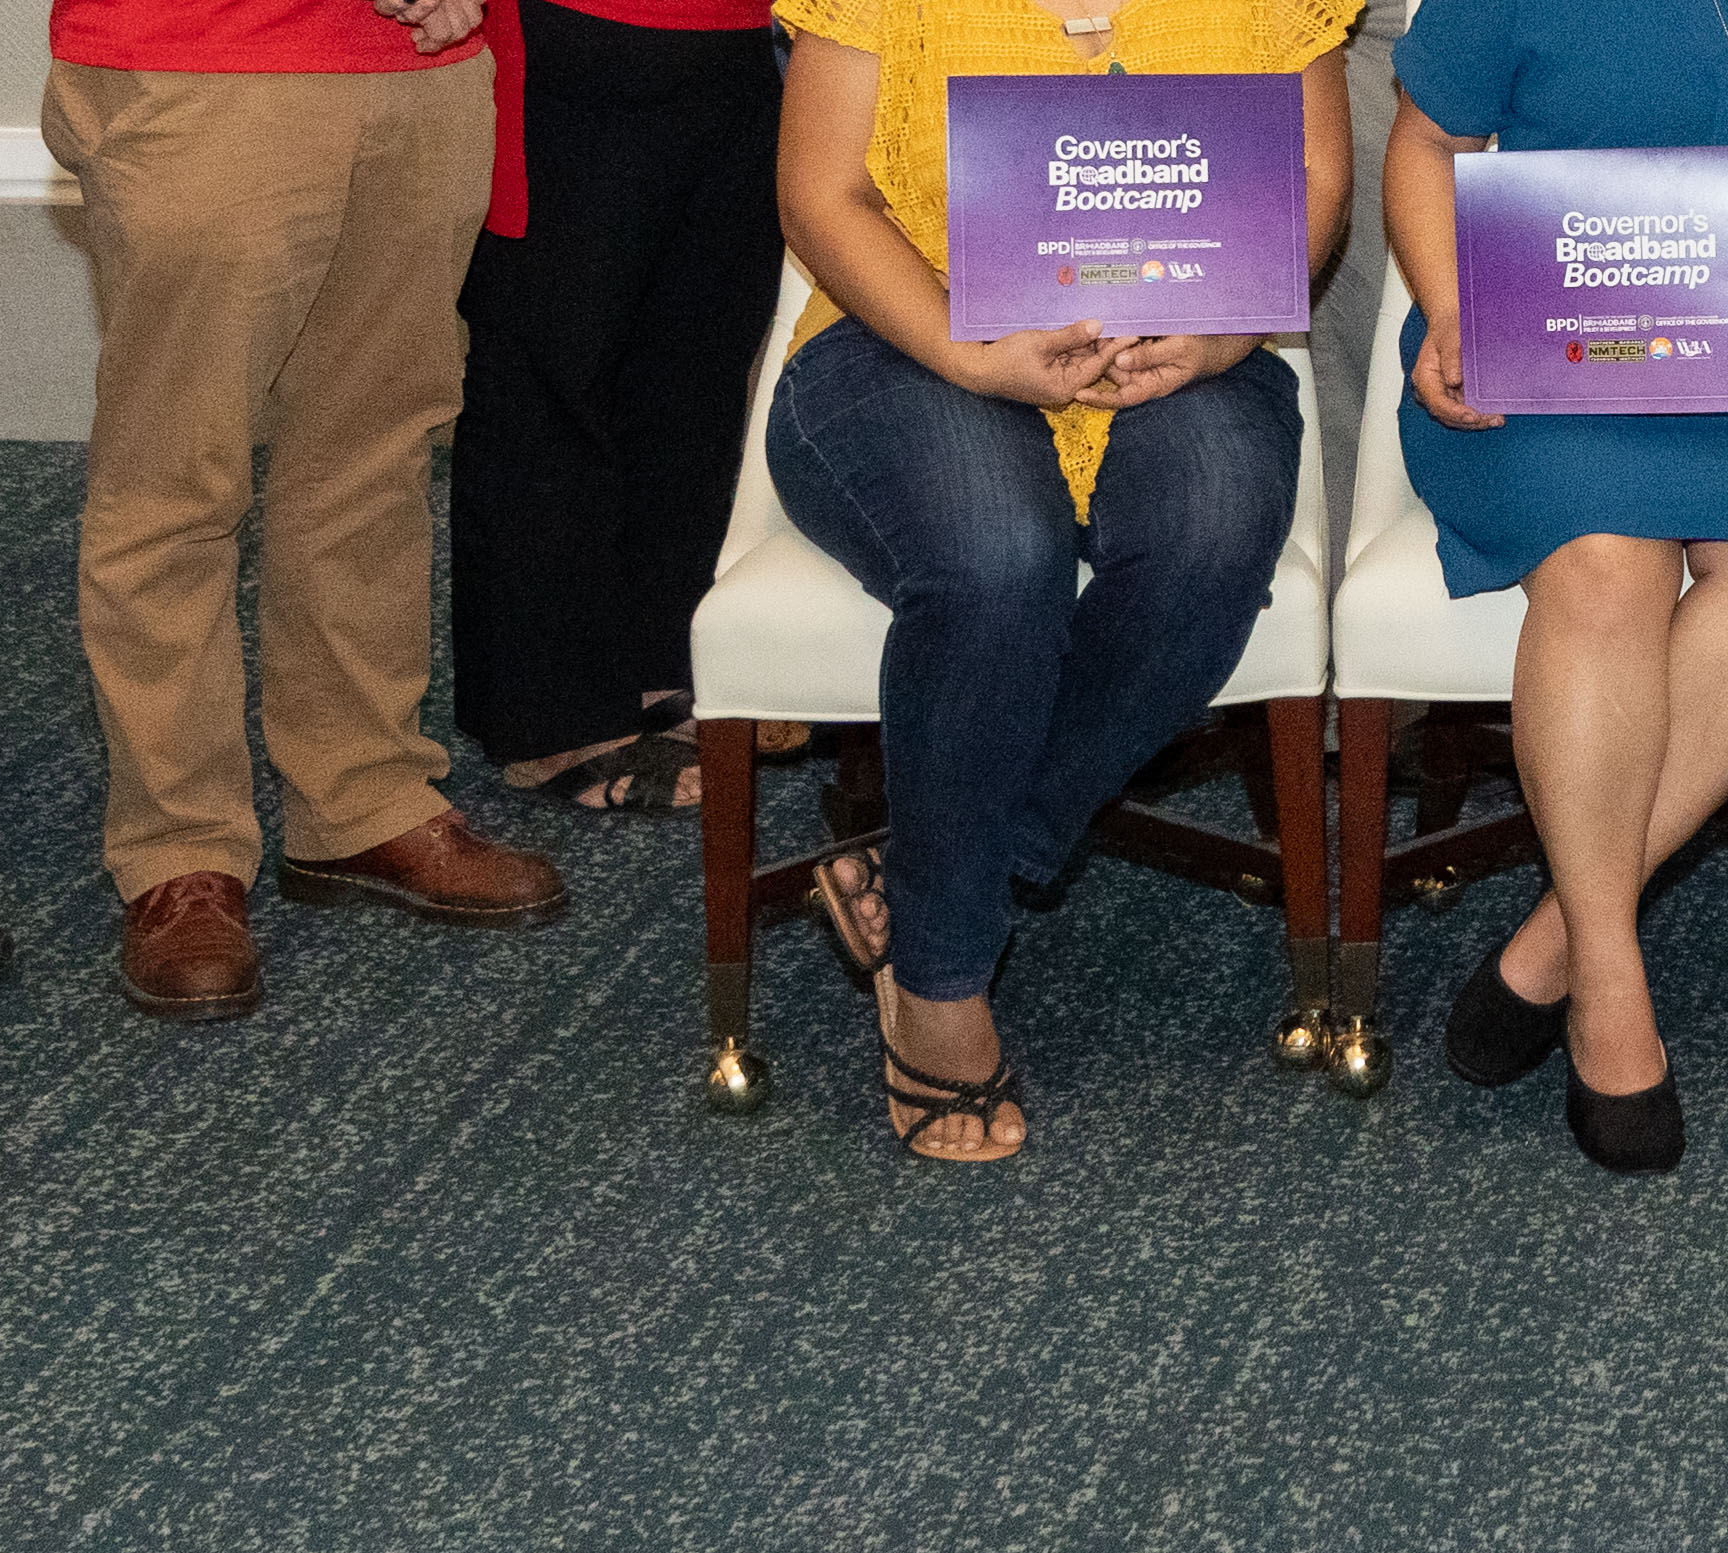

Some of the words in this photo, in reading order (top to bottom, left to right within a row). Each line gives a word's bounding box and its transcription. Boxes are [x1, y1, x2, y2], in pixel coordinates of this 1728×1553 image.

[1055, 133, 1201, 160] Governor's
[1055, 186, 1203, 213] Bootcamp
[1562, 209, 1709, 236] Governor's
[1037, 241, 1070, 255] BPD
[1563, 262, 1710, 289] Bootcamp
[1546, 318, 1578, 332] BPD
